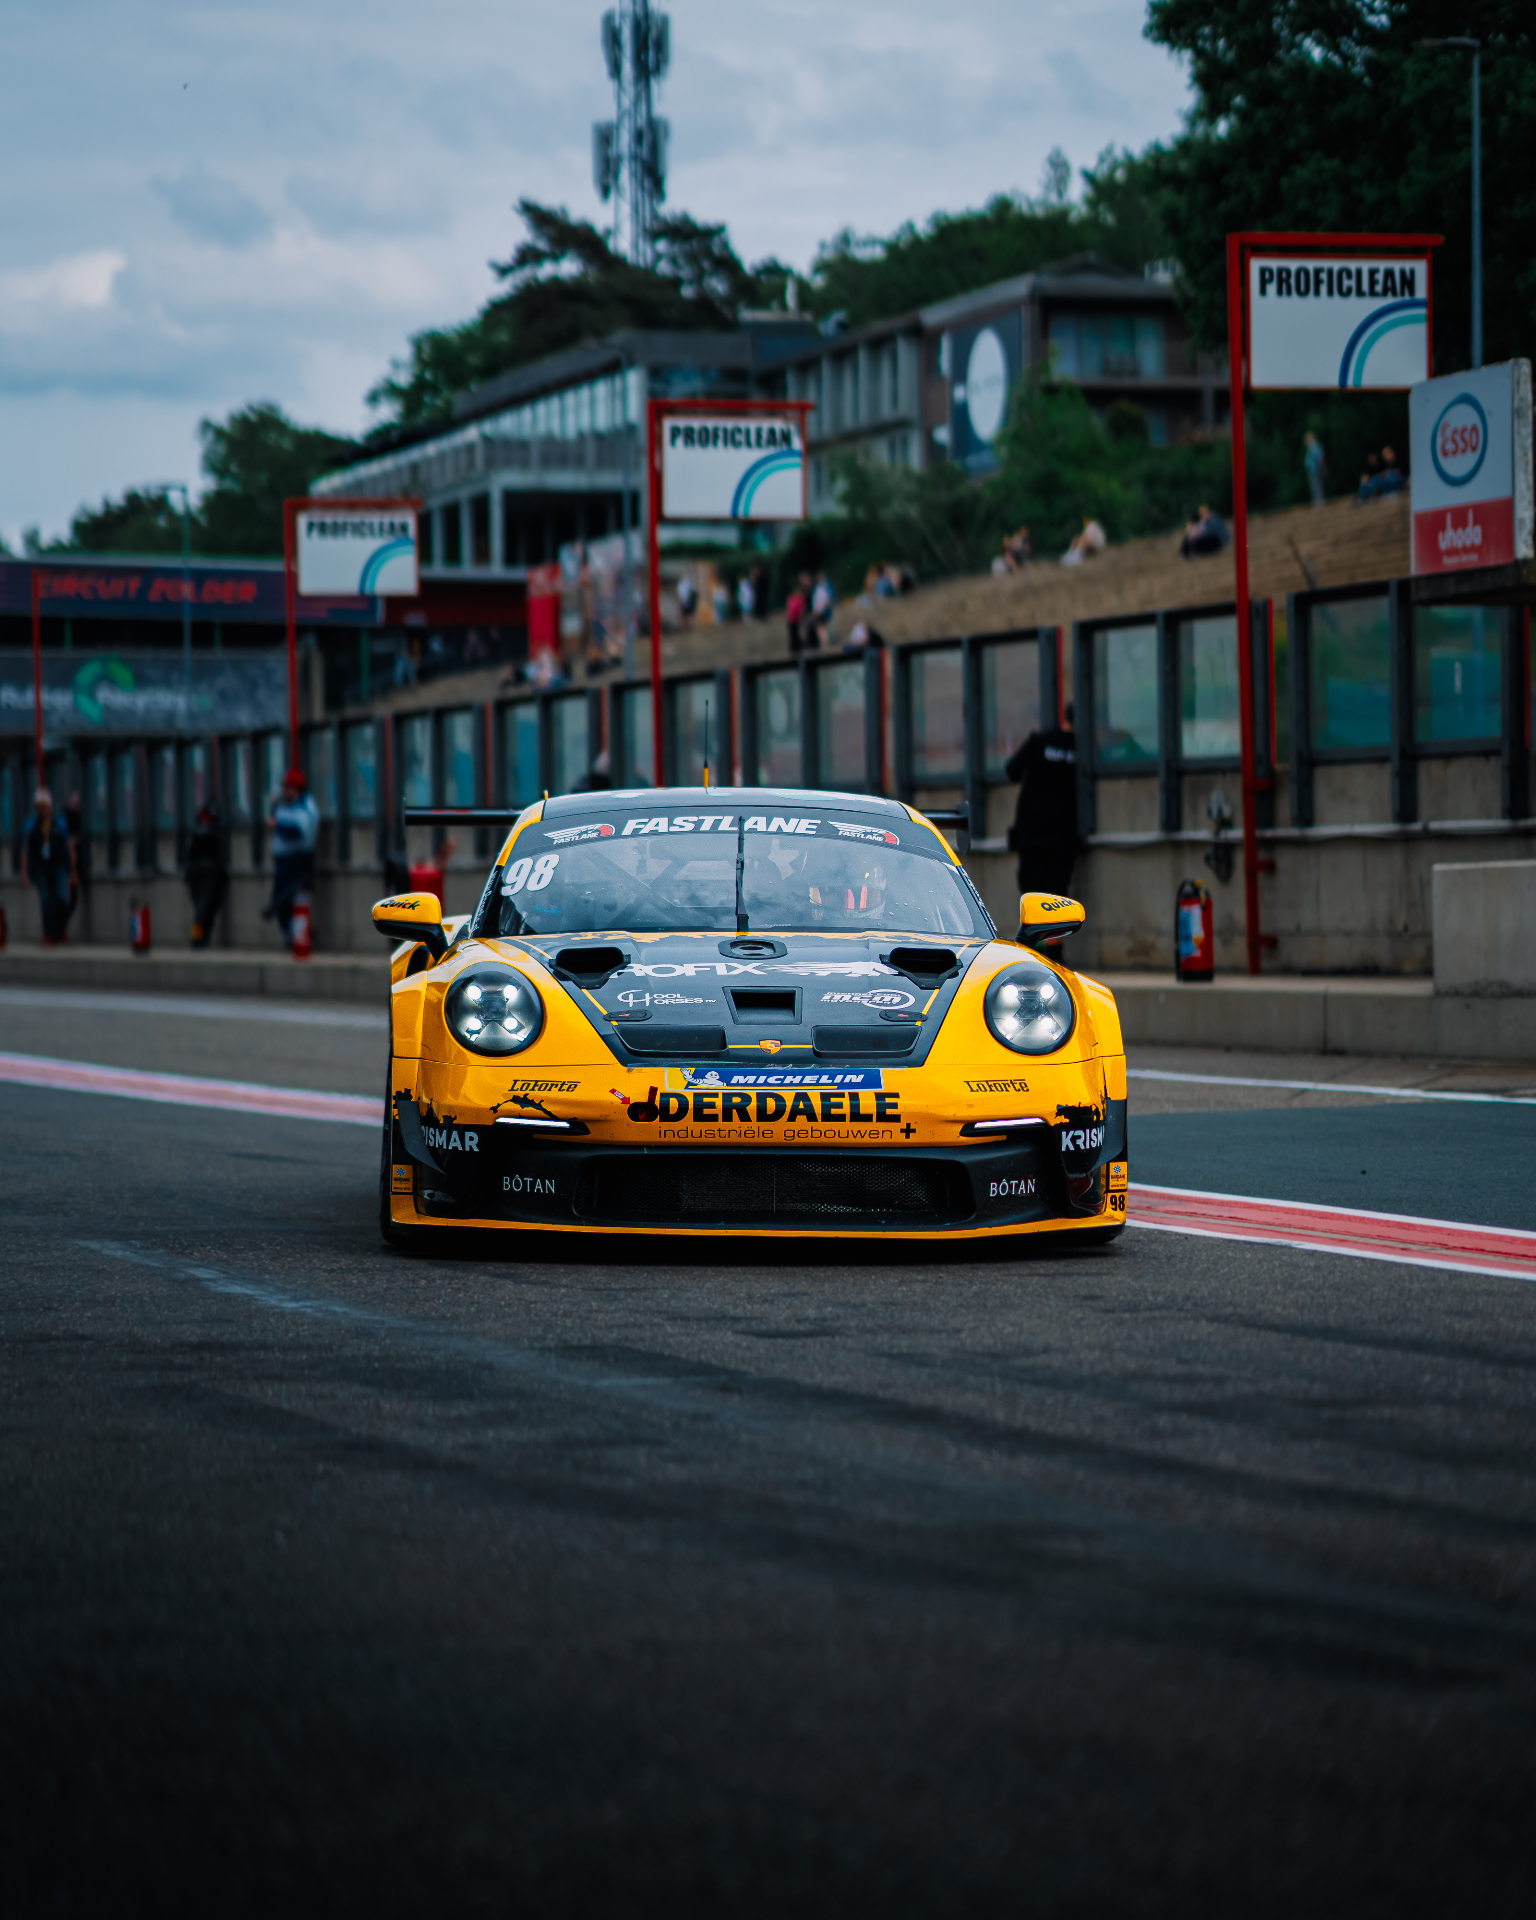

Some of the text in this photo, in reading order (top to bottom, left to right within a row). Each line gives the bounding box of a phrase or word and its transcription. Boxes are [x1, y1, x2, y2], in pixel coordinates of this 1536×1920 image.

[1259, 266, 1415, 298] PROFICLEAN
[670, 426, 792, 448] PROFICLEAN
[308, 521, 409, 537] PROFICLEAN
[148, 578, 257, 604] ZOLDER
[621, 816, 821, 835] FASTLANE
[553, 832, 599, 845] FASTLANE
[838, 830, 884, 842] FASTLANE
[501, 854, 560, 896] 98
[381, 899, 420, 911] Quick
[1040, 898, 1076, 911] Quick
[730, 1073, 865, 1085] MICHELIN
[658, 1126, 894, 1141] industriële gebouwen
[502, 1174, 556, 1194] BÔTAN
[989, 1178, 1036, 1197] BÔTAN
[1109, 1194, 1125, 1212] 98
